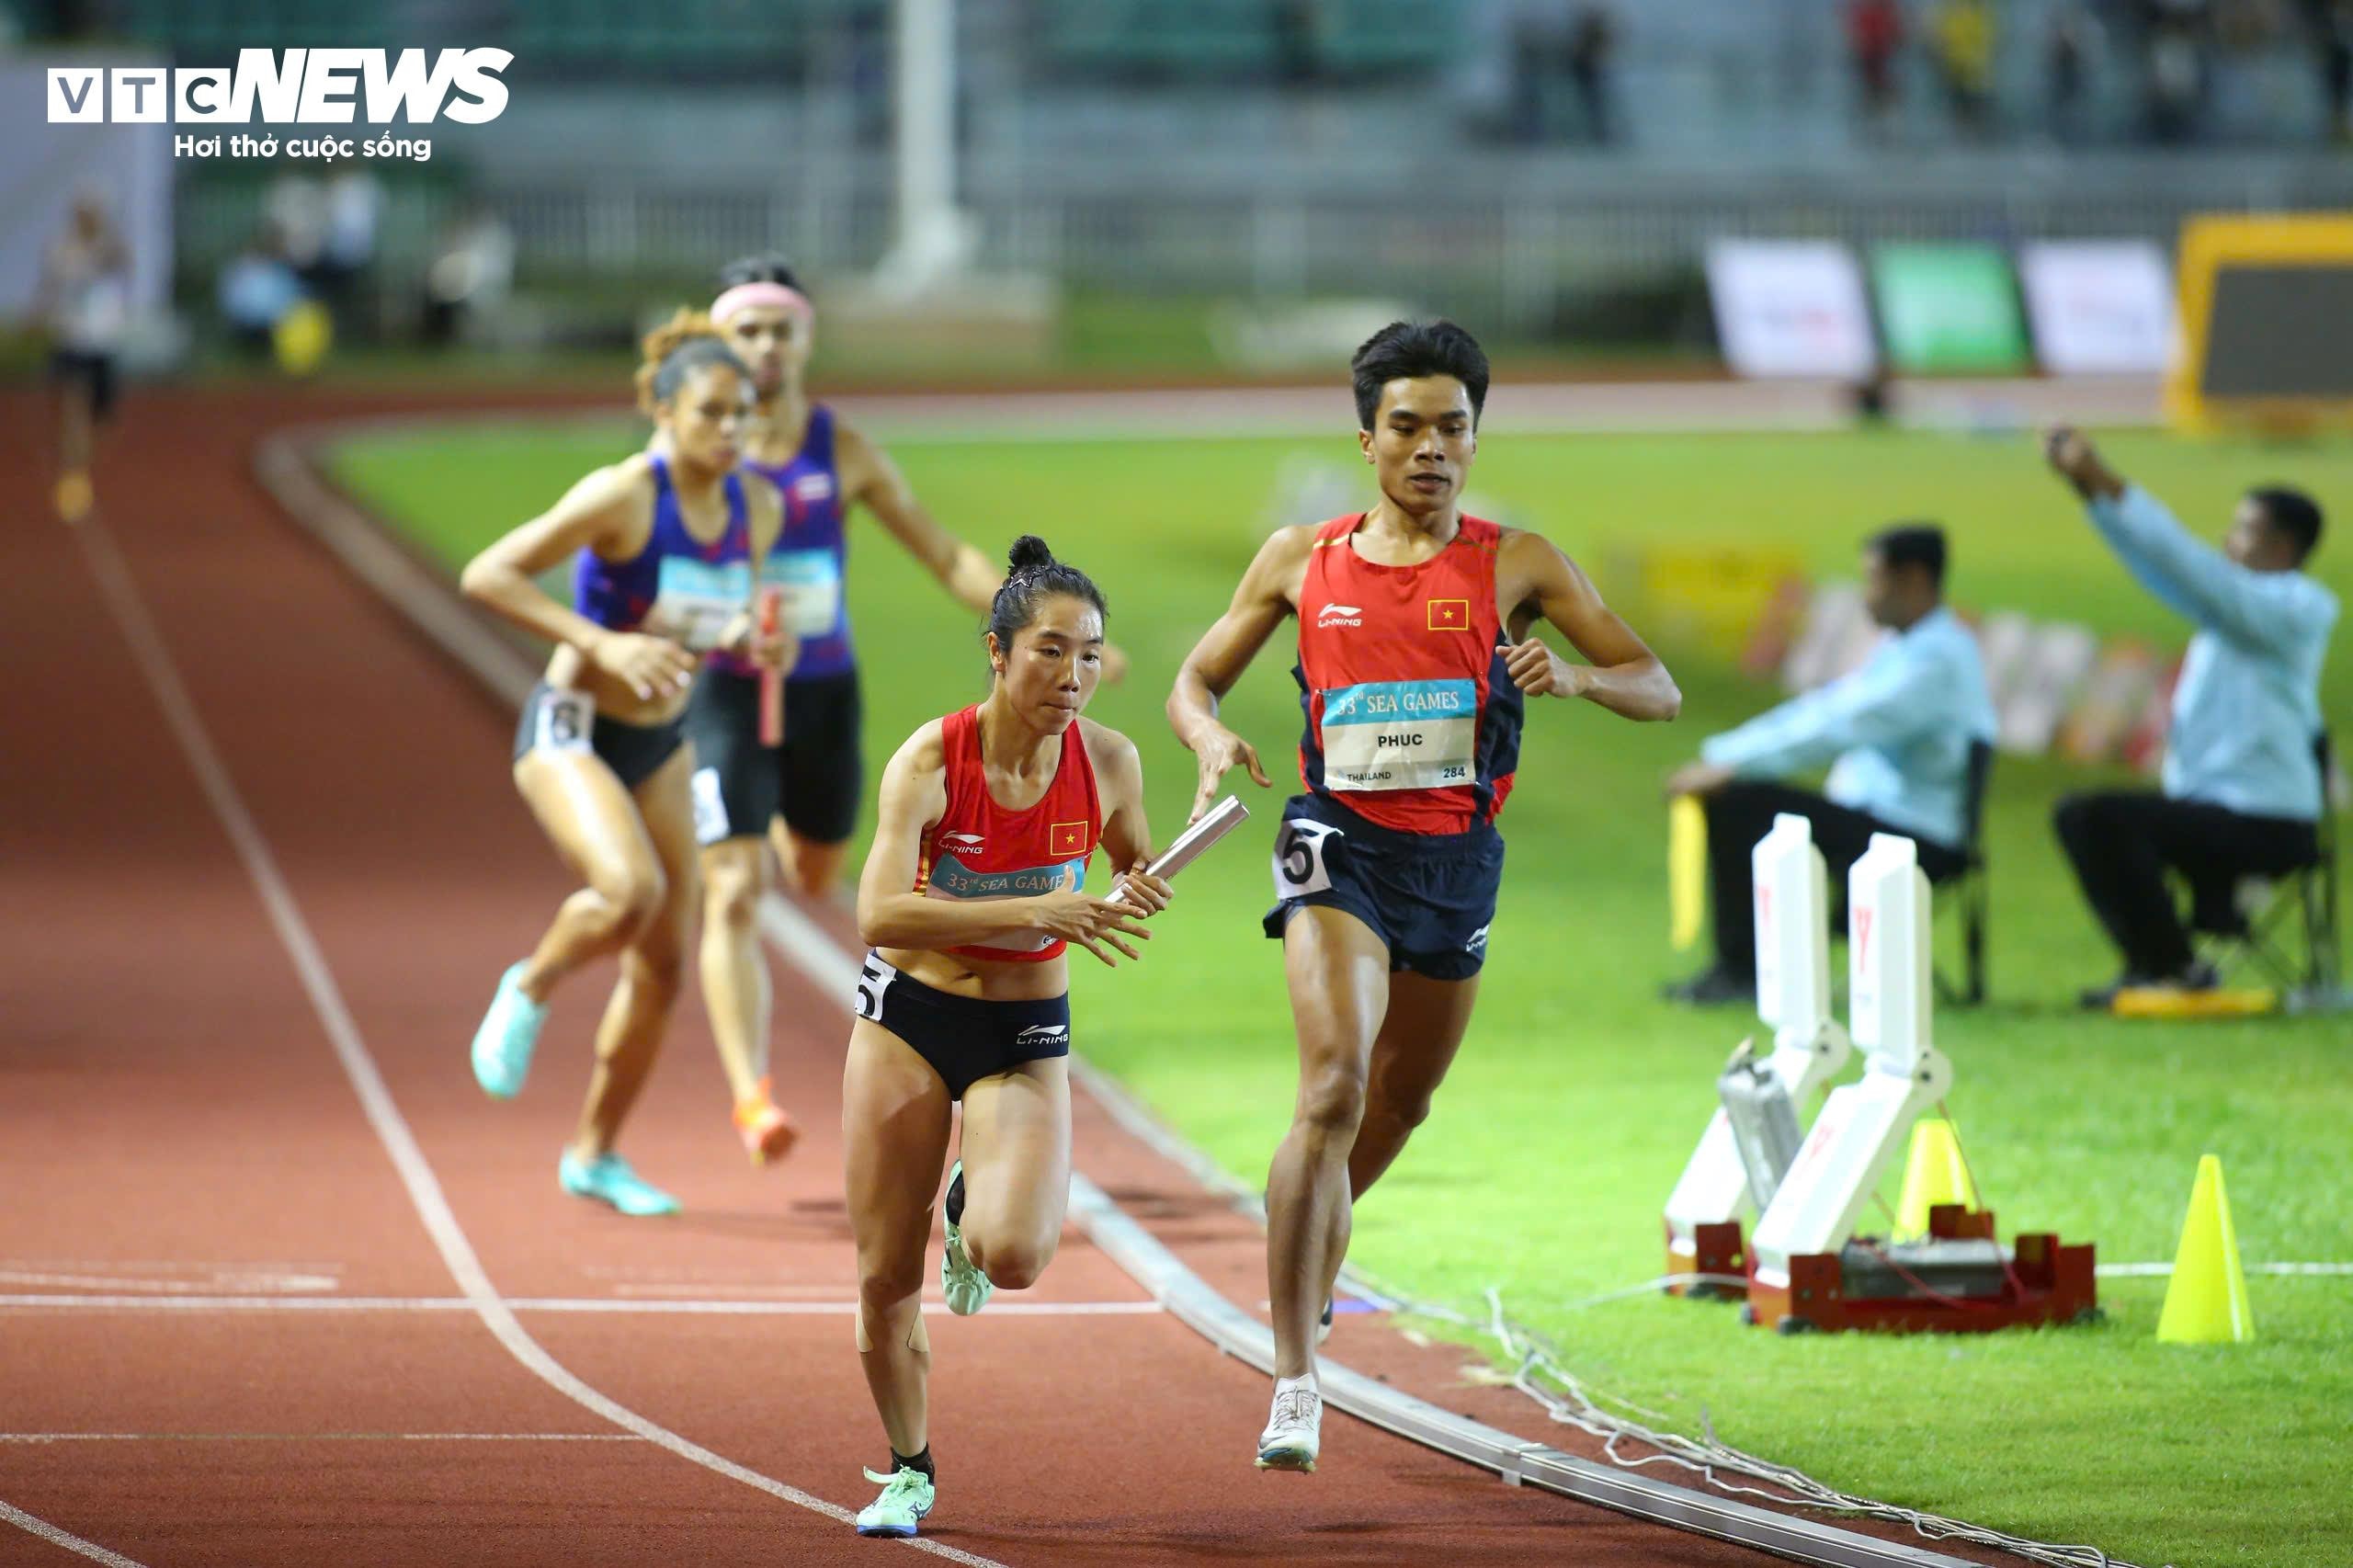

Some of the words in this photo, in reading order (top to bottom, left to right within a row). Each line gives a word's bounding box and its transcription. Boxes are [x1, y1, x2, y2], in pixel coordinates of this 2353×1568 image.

[1367, 694, 1398, 714] SEA
[1403, 691, 1460, 711] GAMES
[1378, 733, 1423, 748] PHUC
[1347, 771, 1392, 781] THAILAND
[1443, 767, 1466, 778] 284
[938, 839, 983, 855] LI-NING
[1282, 829, 1319, 884] 5
[979, 877, 1008, 892] SEA
[1015, 875, 1064, 891] GAME
[1016, 1033, 1069, 1045] LI-NING
